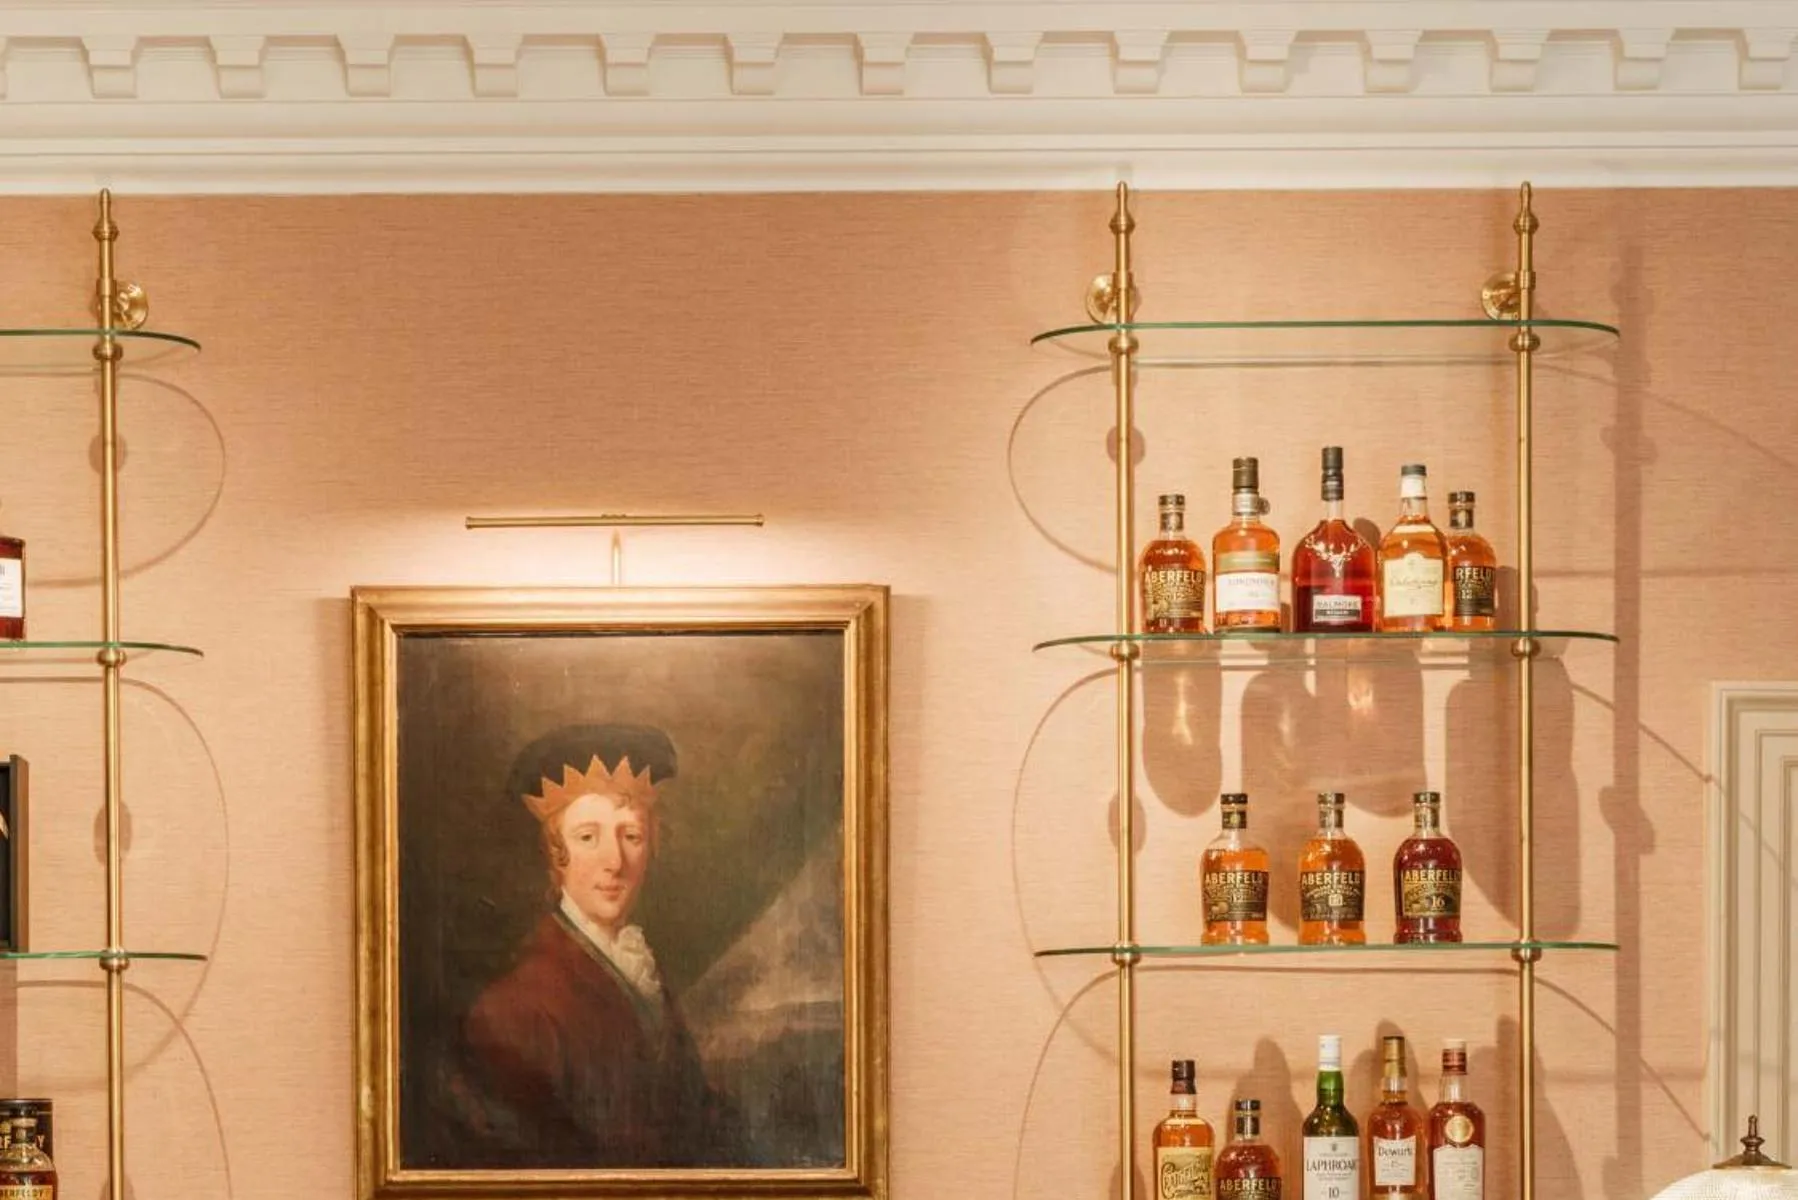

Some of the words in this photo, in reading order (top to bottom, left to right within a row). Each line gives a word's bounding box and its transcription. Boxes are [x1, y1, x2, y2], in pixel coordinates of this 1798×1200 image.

[1145, 570, 1204, 583] ABERFELD
[1205, 872, 1264, 884] ABERFELD
[1302, 872, 1361, 885] ABERFELD
[1405, 869, 1459, 881] ABERFELD
[1220, 1179, 1278, 1191] ABERFELD
[1328, 1187, 1340, 1199] 10
